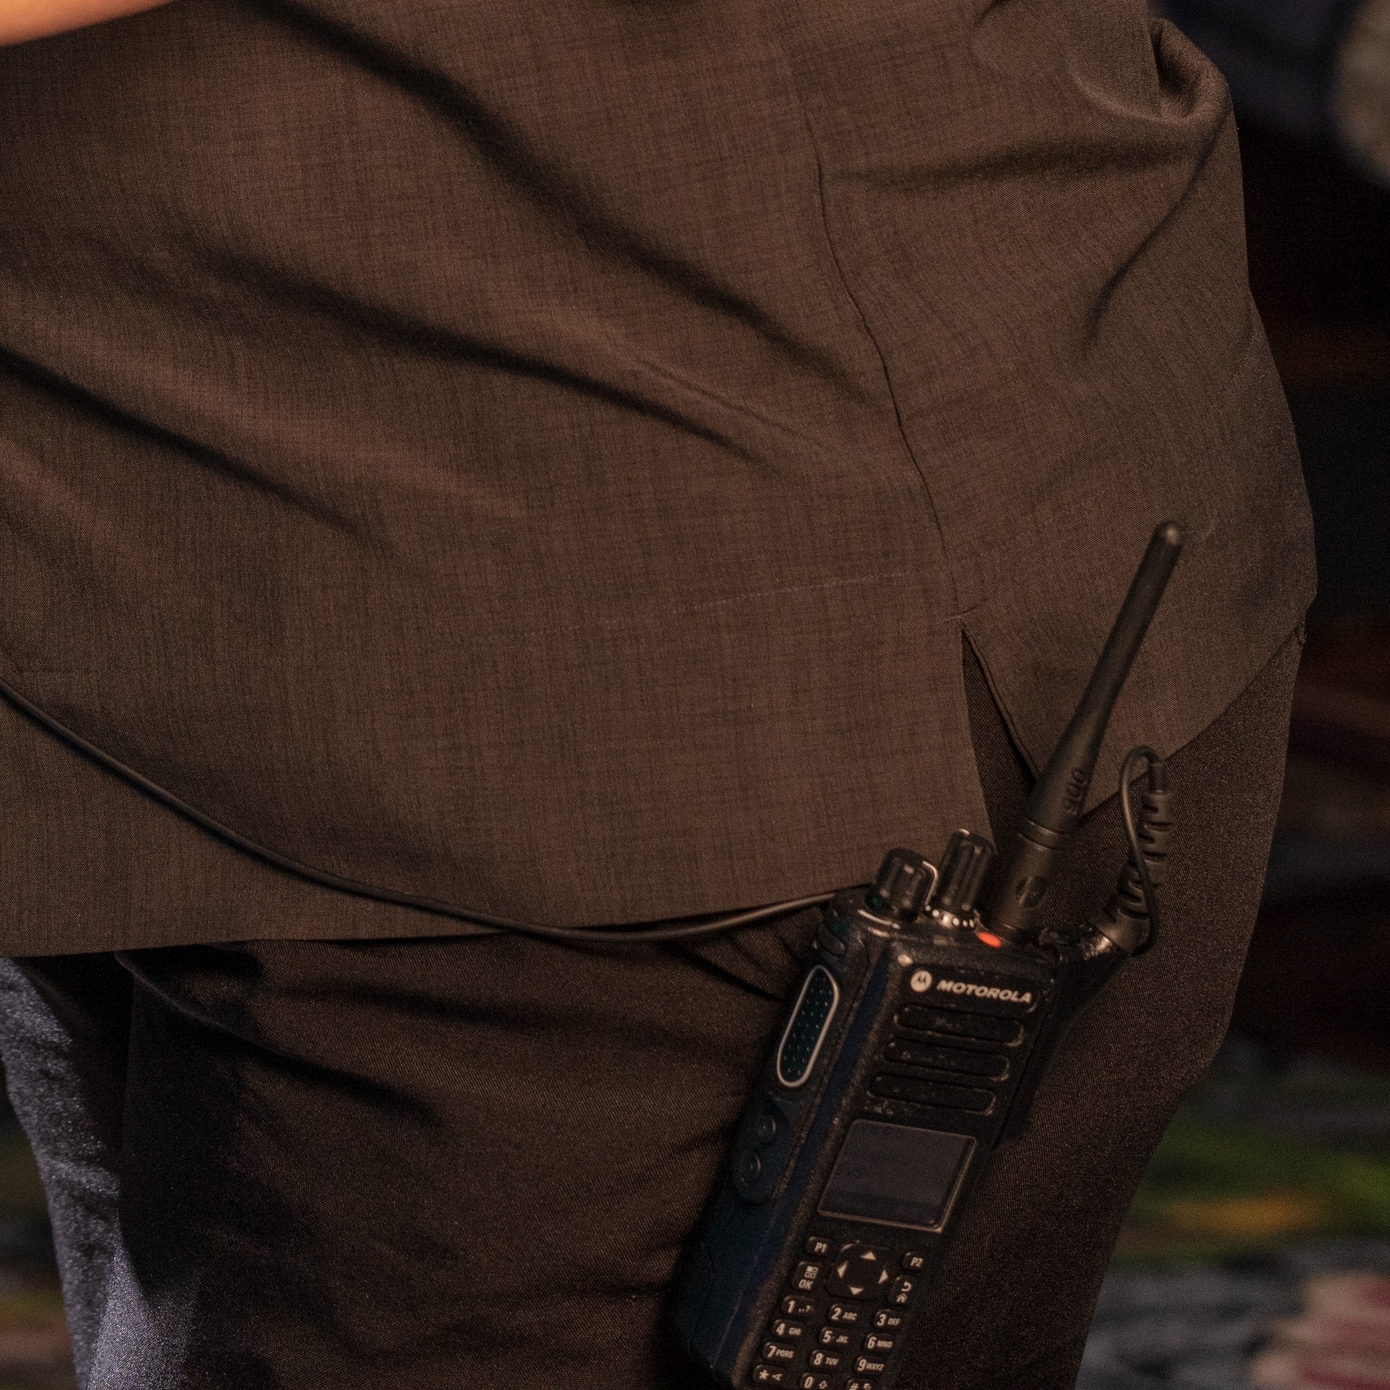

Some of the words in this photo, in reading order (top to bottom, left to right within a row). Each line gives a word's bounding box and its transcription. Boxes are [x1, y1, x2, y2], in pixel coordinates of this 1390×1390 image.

[936, 979, 1032, 1003] MOTOROLA
[814, 1241, 829, 1254] P1
[910, 1256, 924, 1268] P2
[798, 1278, 814, 1291] OK
[787, 1299, 796, 1314] 1
[831, 1307, 842, 1321] 2
[842, 1311, 858, 1321] ABC
[877, 1313, 887, 1327] 3
[887, 1317, 901, 1326] DEF
[775, 1322, 786, 1337] 4
[788, 1327, 802, 1336] GHI
[822, 1330, 832, 1344] 5
[867, 1336, 877, 1350] 6
[876, 1340, 893, 1349] MNO
[767, 1345, 777, 1359] 7
[813, 1352, 824, 1366] 8
[825, 1357, 840, 1366] TUV
[857, 1358, 867, 1372] 9
[866, 1362, 885, 1371] WXYZ
[804, 1376, 814, 1389] 0
